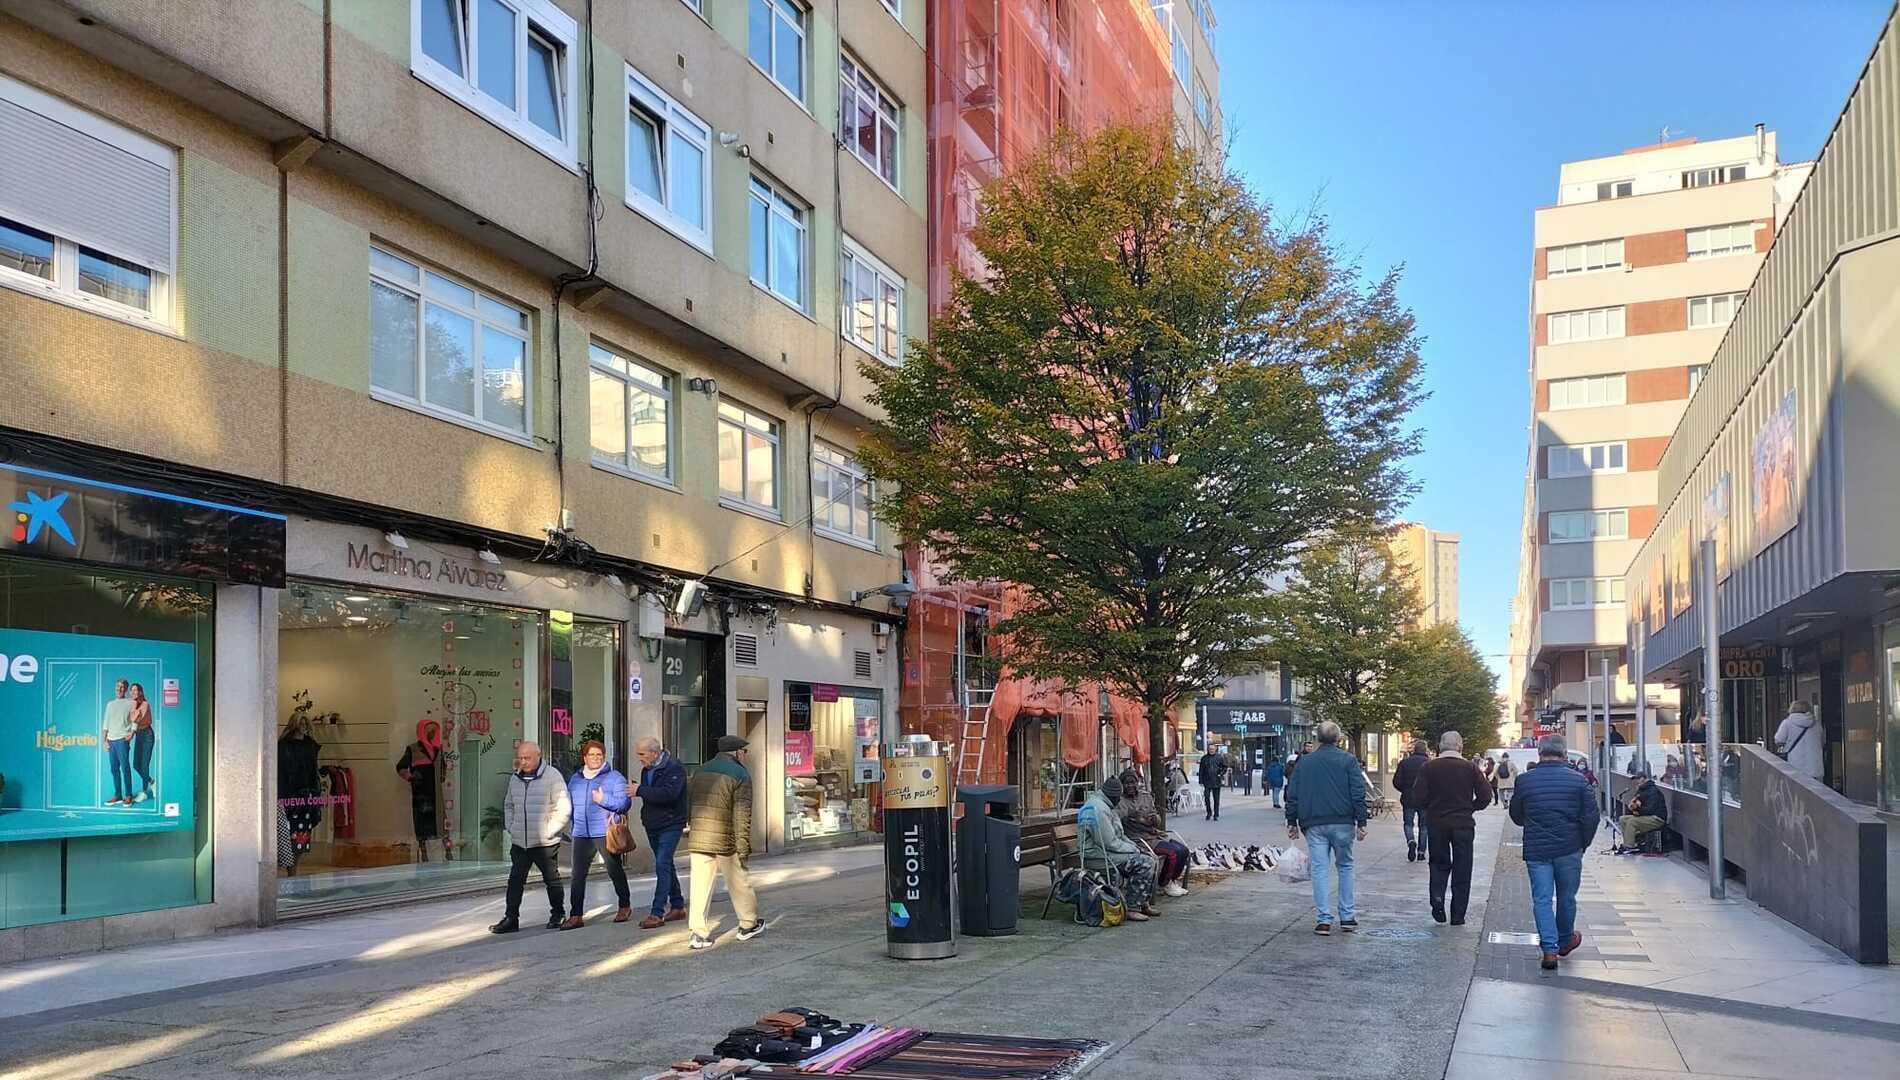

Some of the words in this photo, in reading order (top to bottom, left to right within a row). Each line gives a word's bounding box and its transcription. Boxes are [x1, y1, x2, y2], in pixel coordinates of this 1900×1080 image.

[347, 542, 432, 580] Martina
[666, 656, 683, 676] 29
[1726, 660, 1764, 677] ORO
[1244, 711, 1266, 722] A&B
[904, 824, 920, 900] ECOPIL
